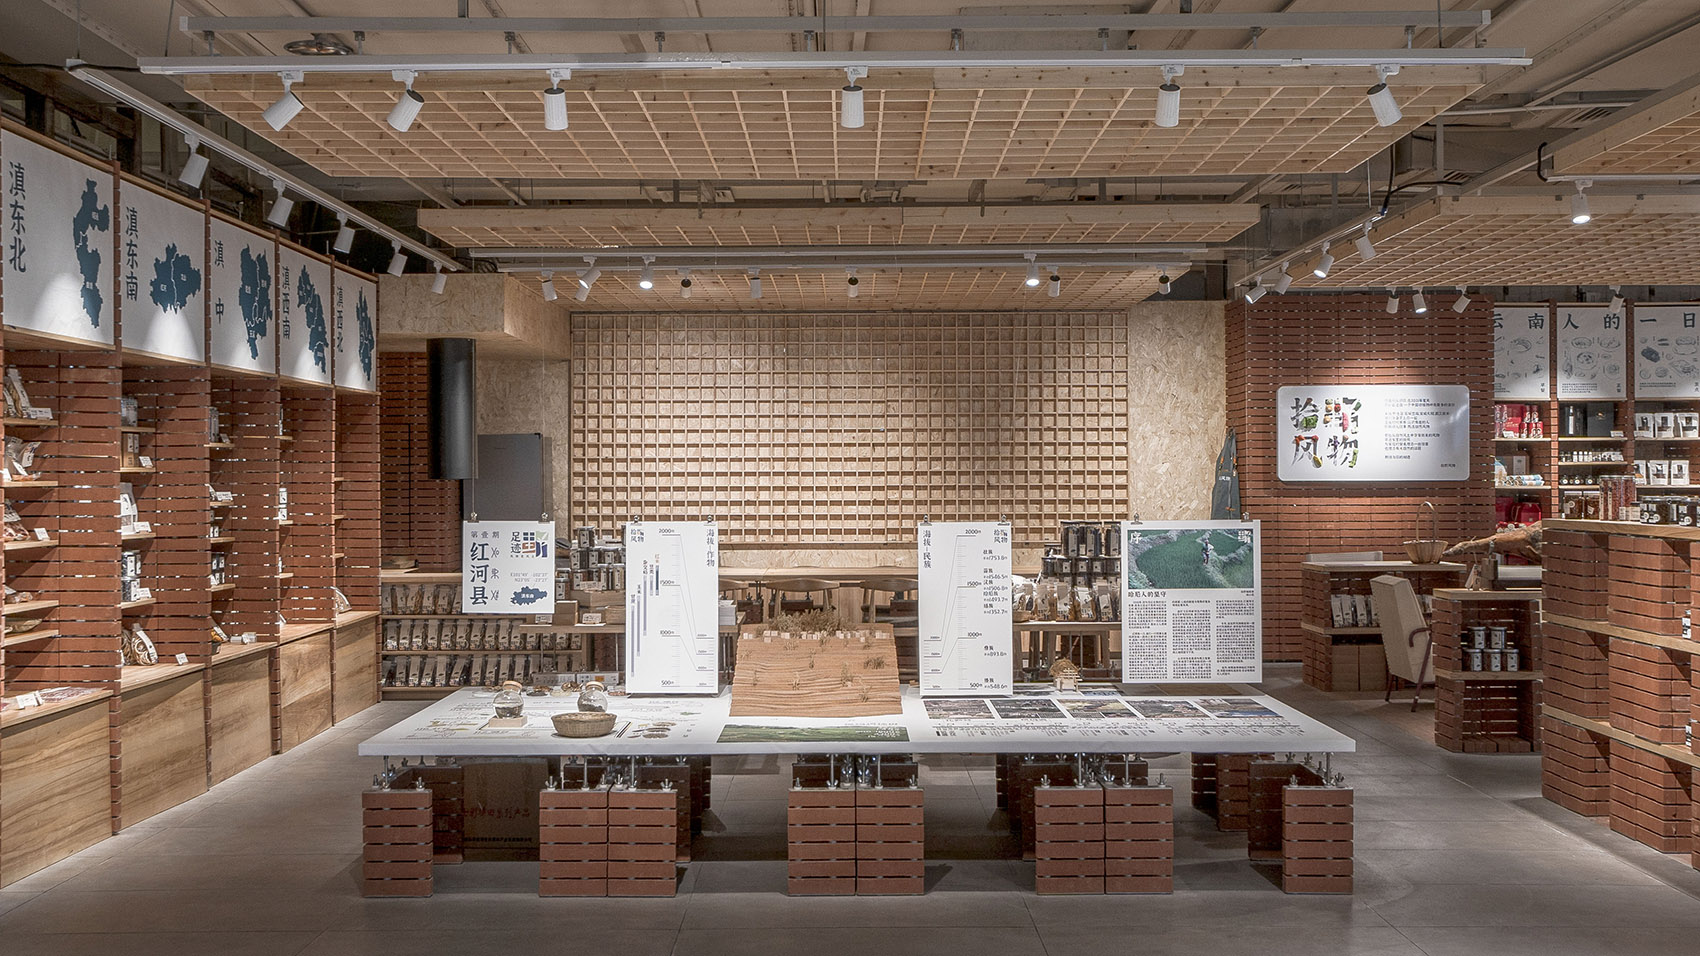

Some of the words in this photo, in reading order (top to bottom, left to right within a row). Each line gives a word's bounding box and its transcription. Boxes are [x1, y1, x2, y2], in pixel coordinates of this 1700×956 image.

[8, 161, 26, 274] 滇东北
[126, 206, 138, 302] 滇东南
[470, 542, 489, 606] 红河县
